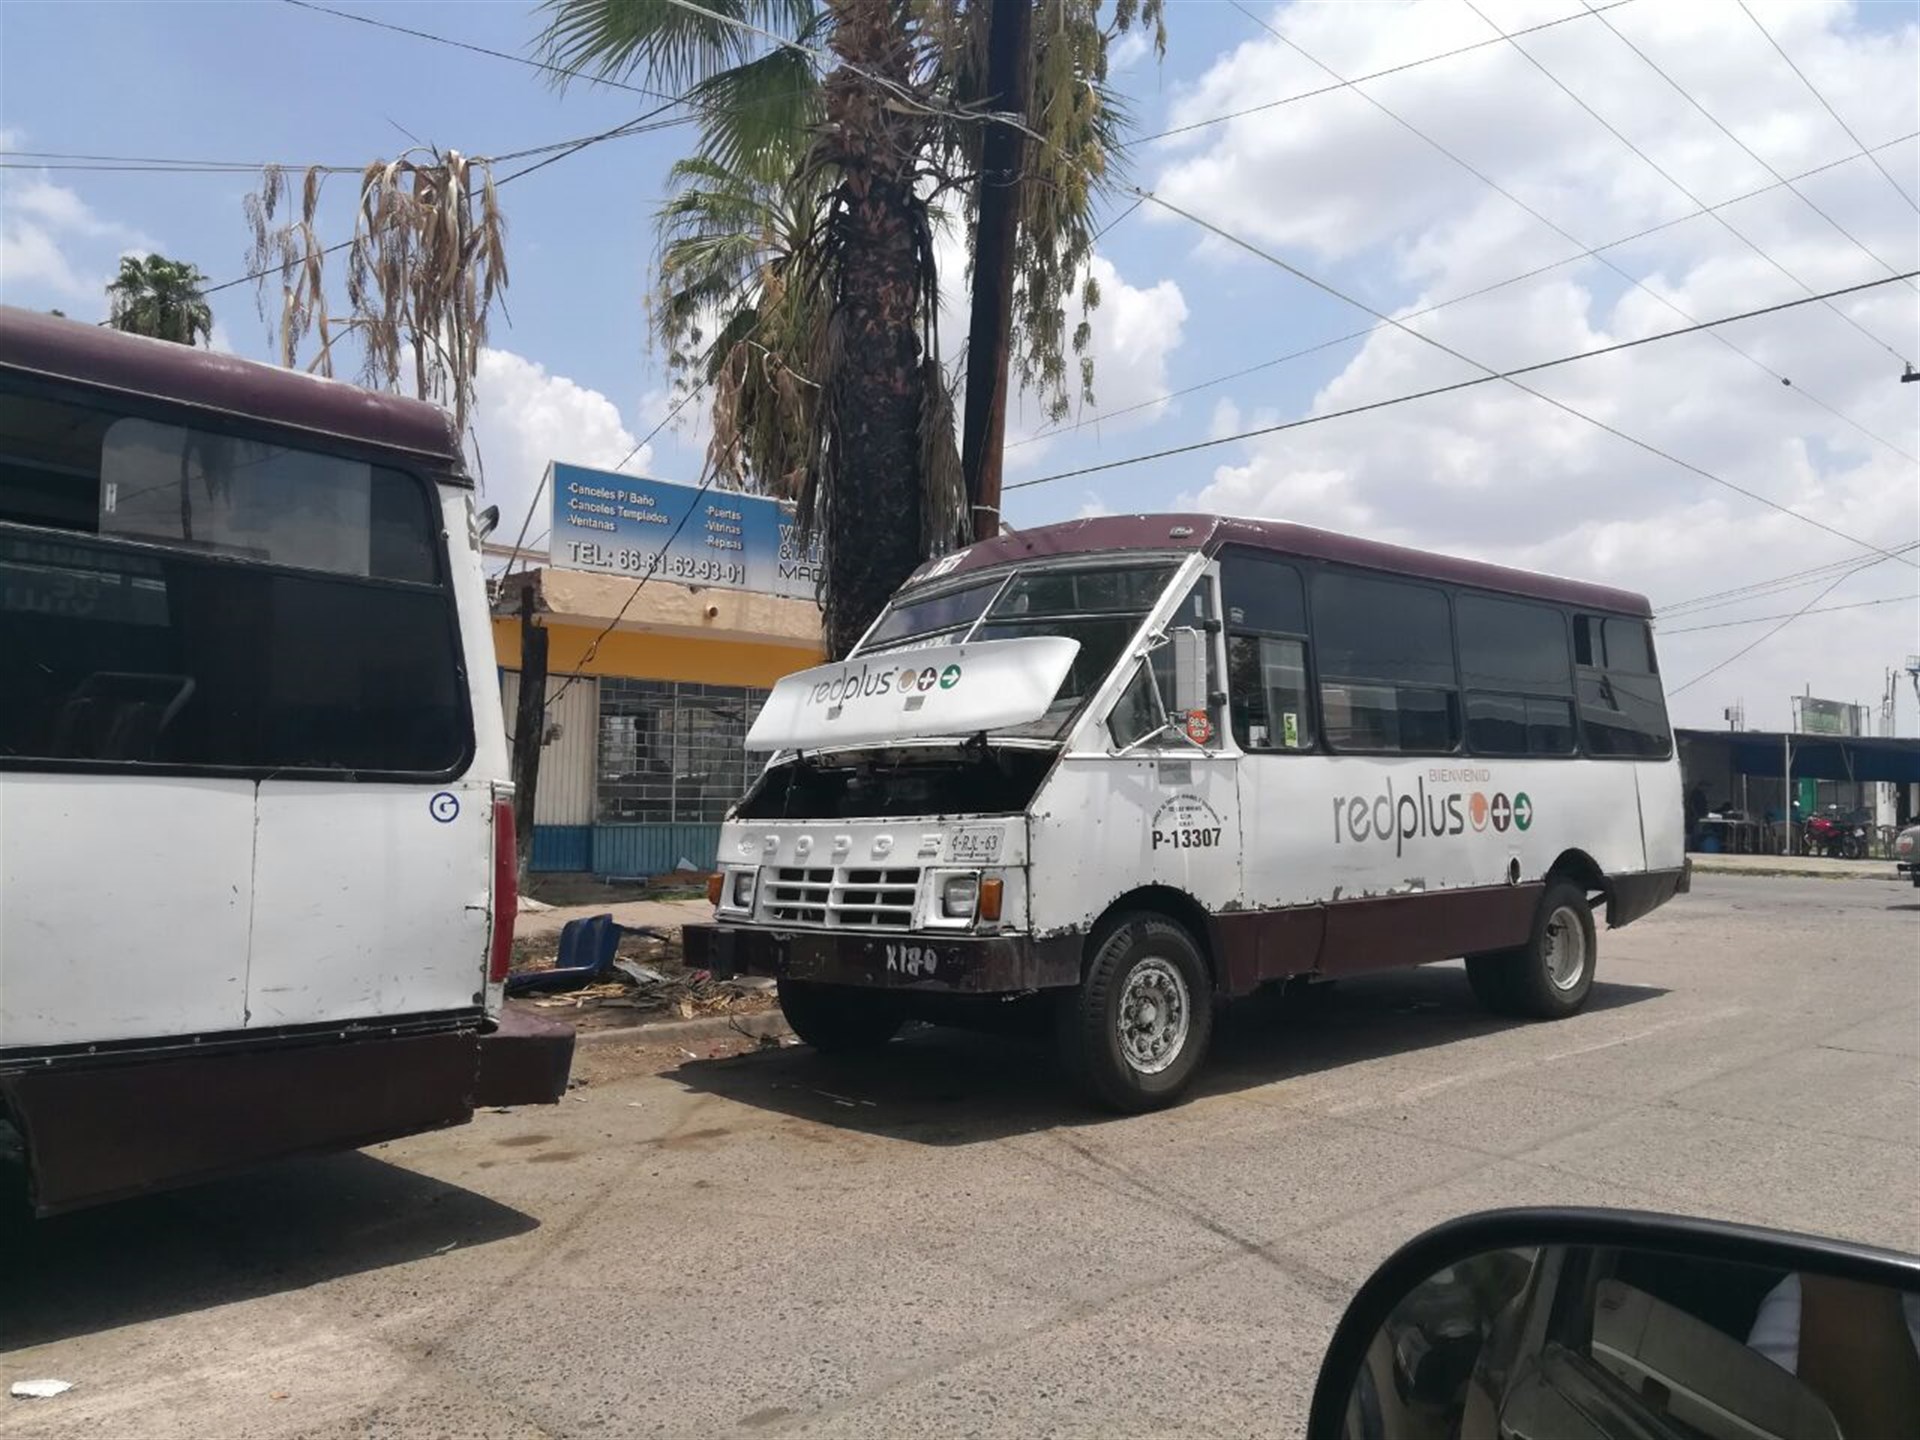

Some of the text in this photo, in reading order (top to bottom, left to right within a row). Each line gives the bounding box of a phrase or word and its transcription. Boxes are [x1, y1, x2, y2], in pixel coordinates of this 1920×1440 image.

[617, 506, 669, 524] Templados
[567, 541, 613, 567] TEL:
[807, 663, 894, 710] redplus
[1333, 776, 1465, 858] redplus
[1152, 828, 1222, 850] P-13307
